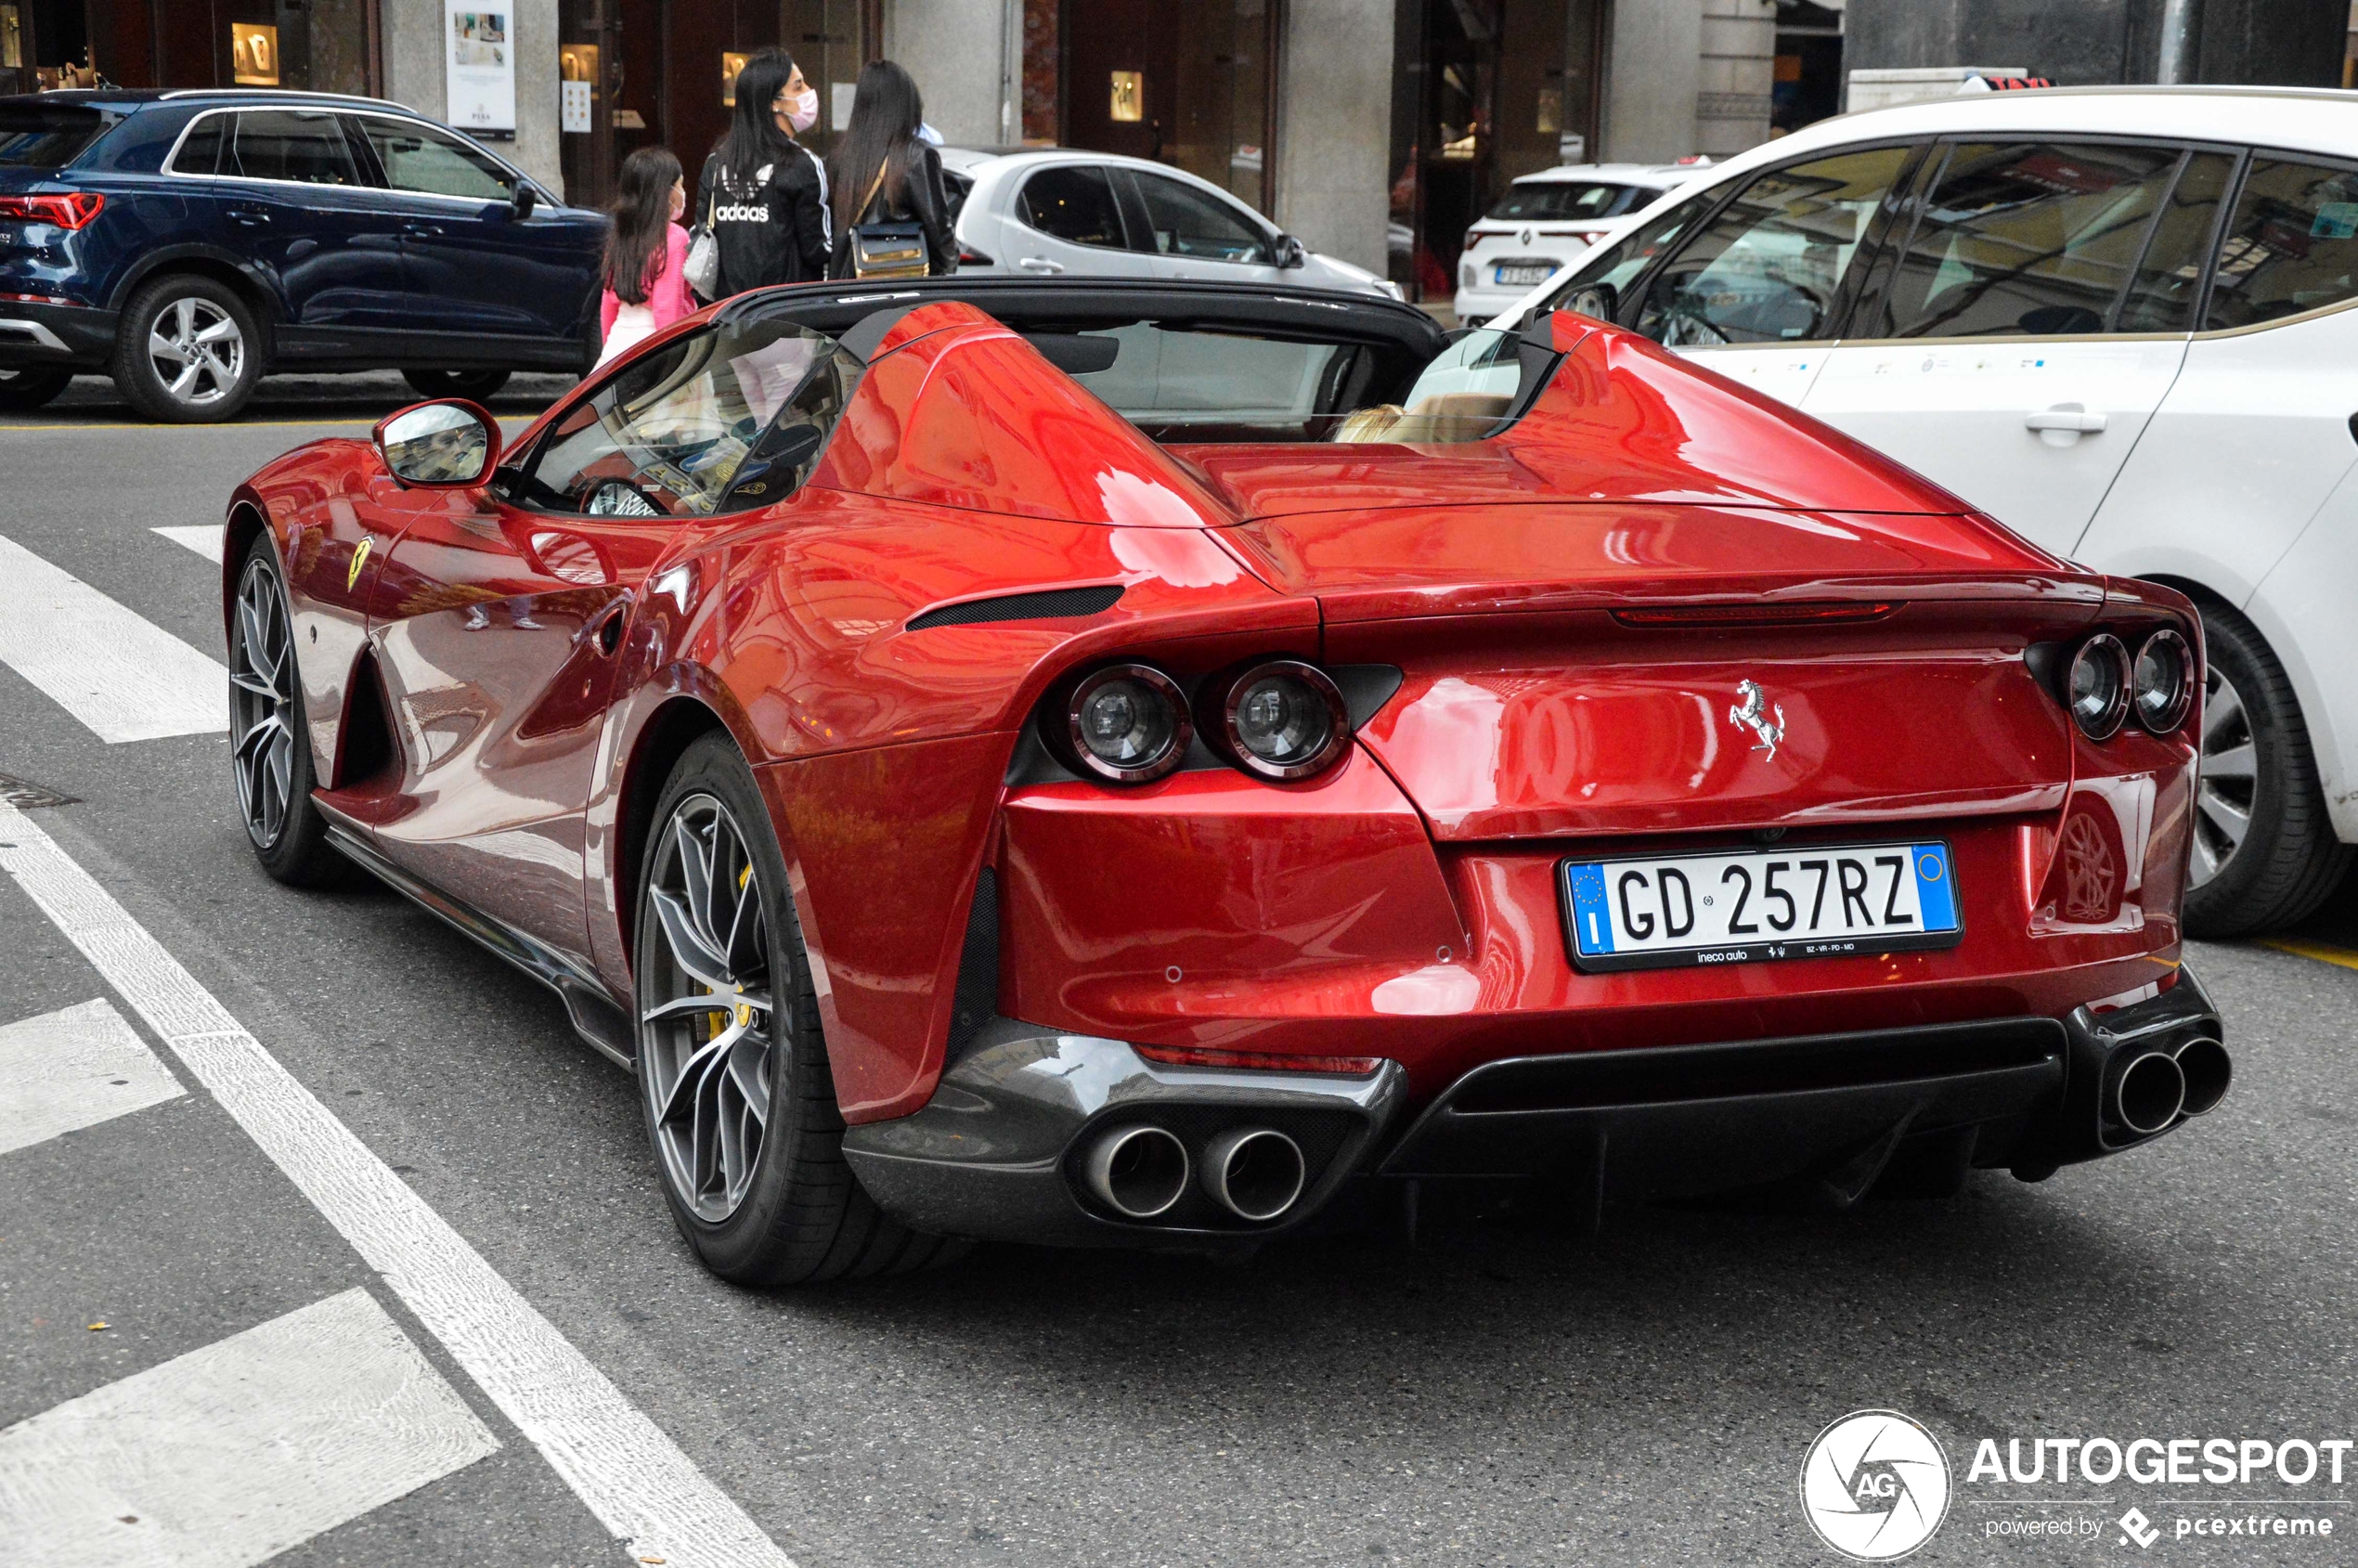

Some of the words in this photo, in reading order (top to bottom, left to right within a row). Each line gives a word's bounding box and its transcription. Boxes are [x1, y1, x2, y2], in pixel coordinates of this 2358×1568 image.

[1988, 77, 2050, 91] TAXI
[716, 202, 769, 222] addas
[1618, 867, 1695, 940] GD
[1720, 855, 1914, 935] 257RZ
[1587, 913, 1600, 944] I
[1697, 952, 1725, 963] ineco
[1726, 949, 1748, 961] auto
